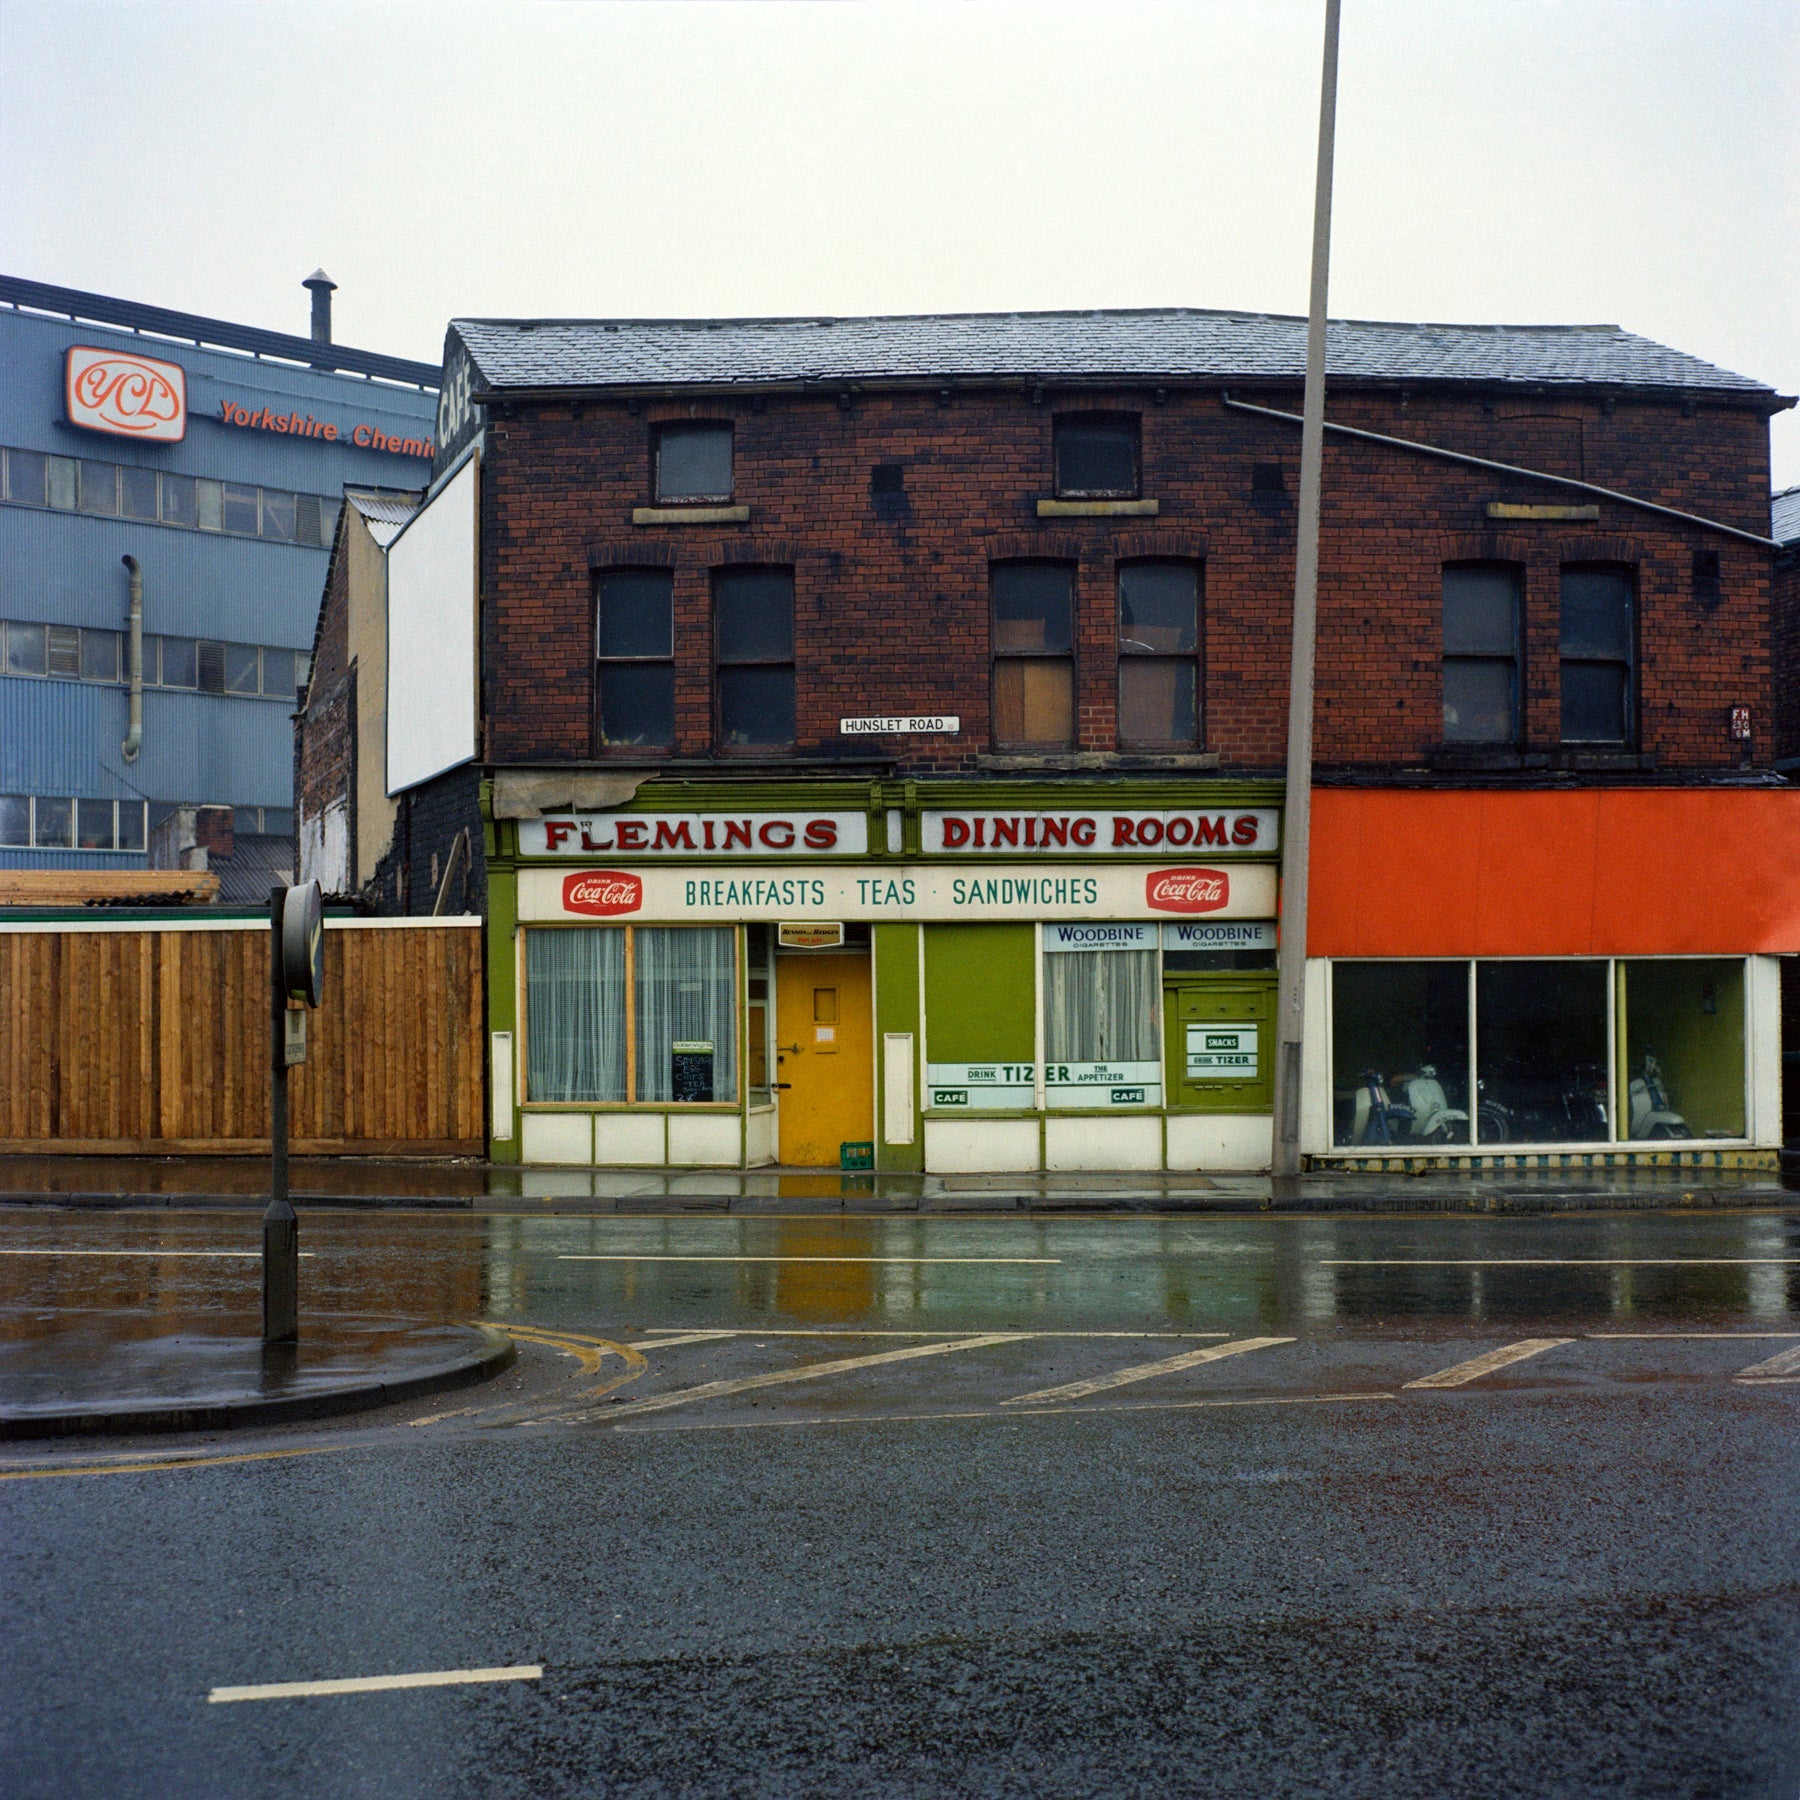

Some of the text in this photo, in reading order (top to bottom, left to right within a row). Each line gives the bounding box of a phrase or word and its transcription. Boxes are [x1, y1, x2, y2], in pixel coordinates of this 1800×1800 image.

[220, 400, 338, 441] Yorkshire
[846, 719, 902, 731] HUNSLET
[909, 719, 944, 730] ROAD
[545, 815, 1259, 850] FLEMINGS DINING ROOMS
[569, 882, 638, 904] Coca-Cola
[686, 877, 1098, 906] BREAKFASTS TEAS SANDWICHES
[1153, 879, 1224, 901] Coca-Cola
[1208, 1038, 1237, 1047] SNACKS
[1216, 1056, 1249, 1064] TIZER
[1003, 1066, 1071, 1081] TIZER
[936, 1092, 966, 1102] CAFÉ
[1113, 1090, 1143, 1100] CAFÉ
